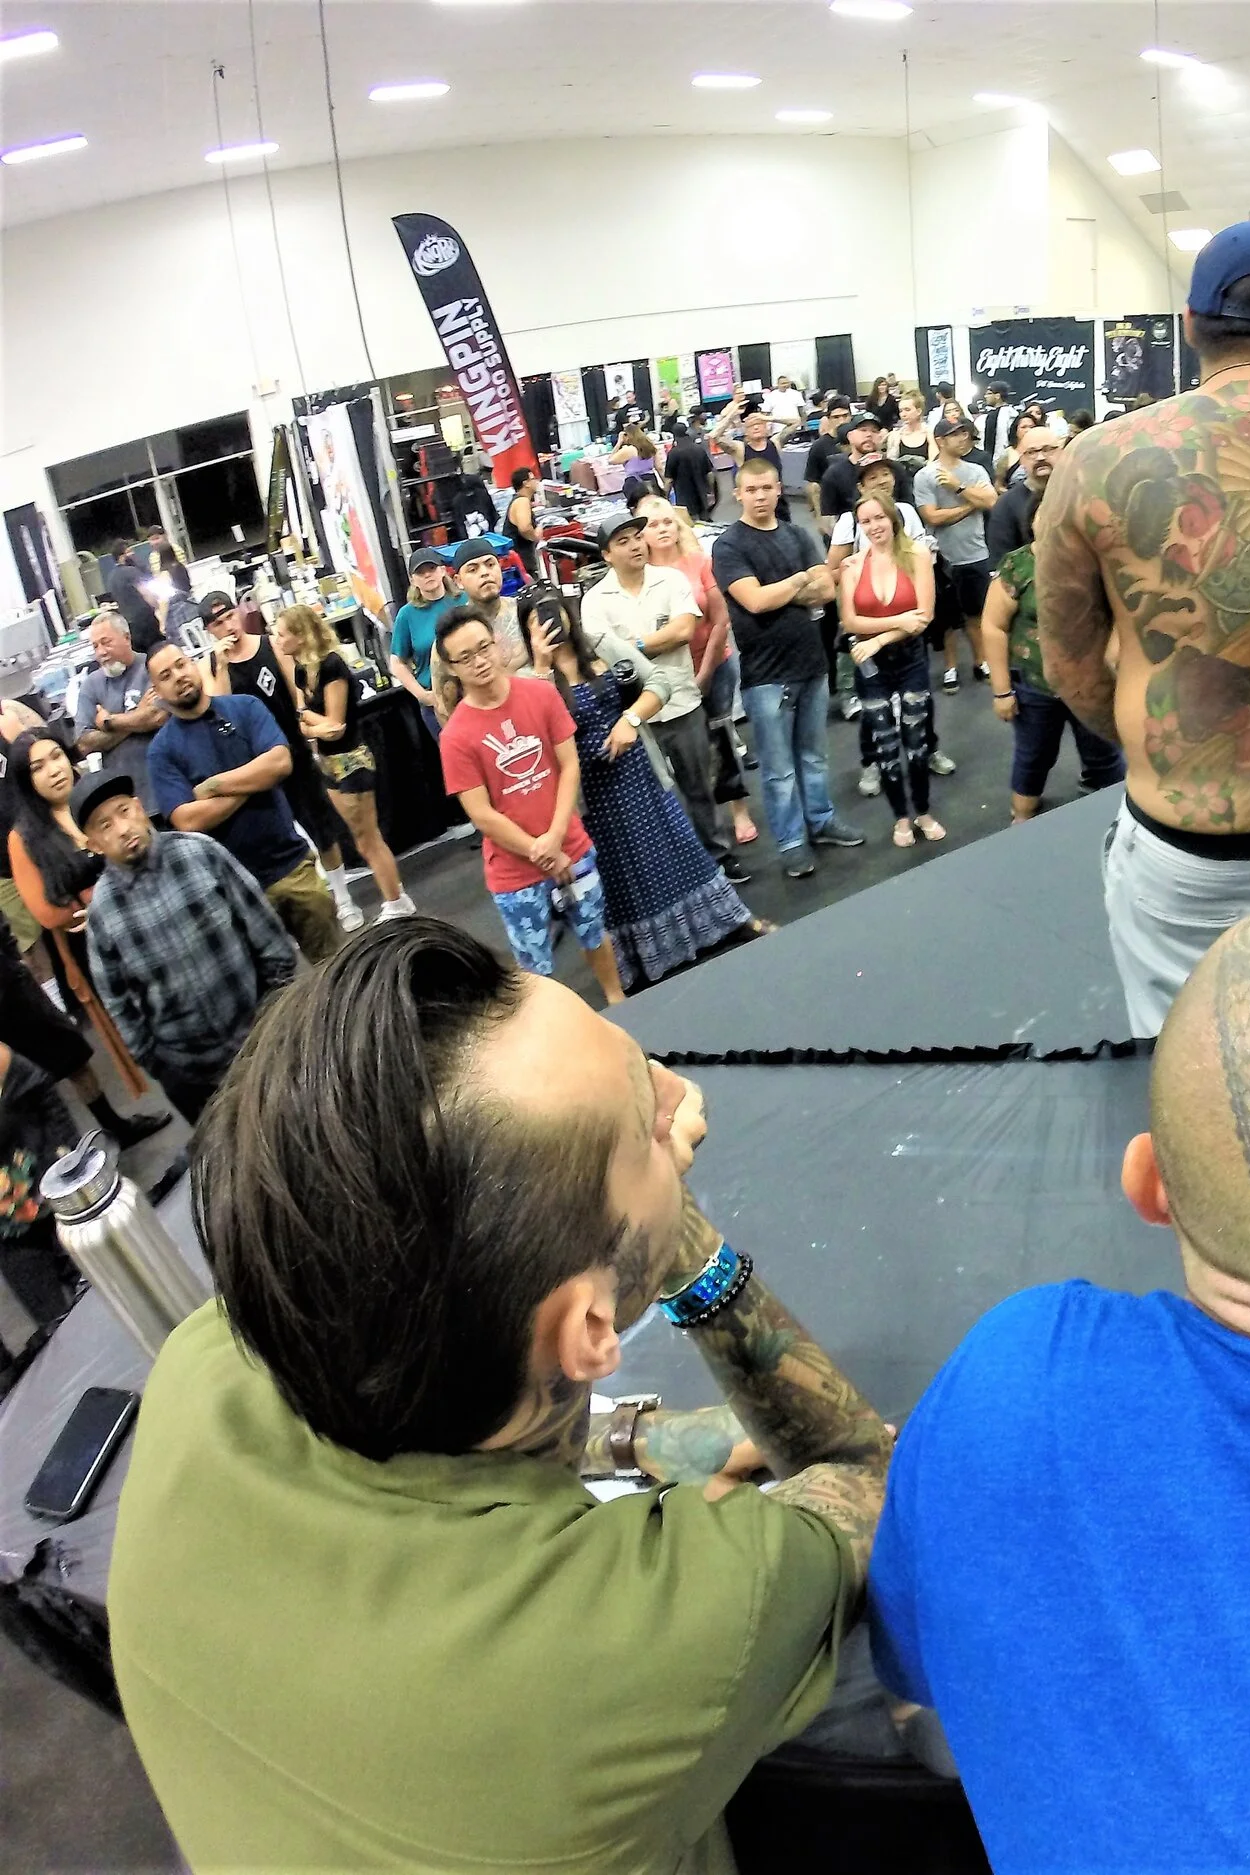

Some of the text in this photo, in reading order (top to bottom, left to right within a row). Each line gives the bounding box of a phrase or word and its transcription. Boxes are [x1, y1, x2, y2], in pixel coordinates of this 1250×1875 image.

[432, 299, 518, 457] KINGPIN
[462, 297, 526, 445] TATTOO SUPPLY
